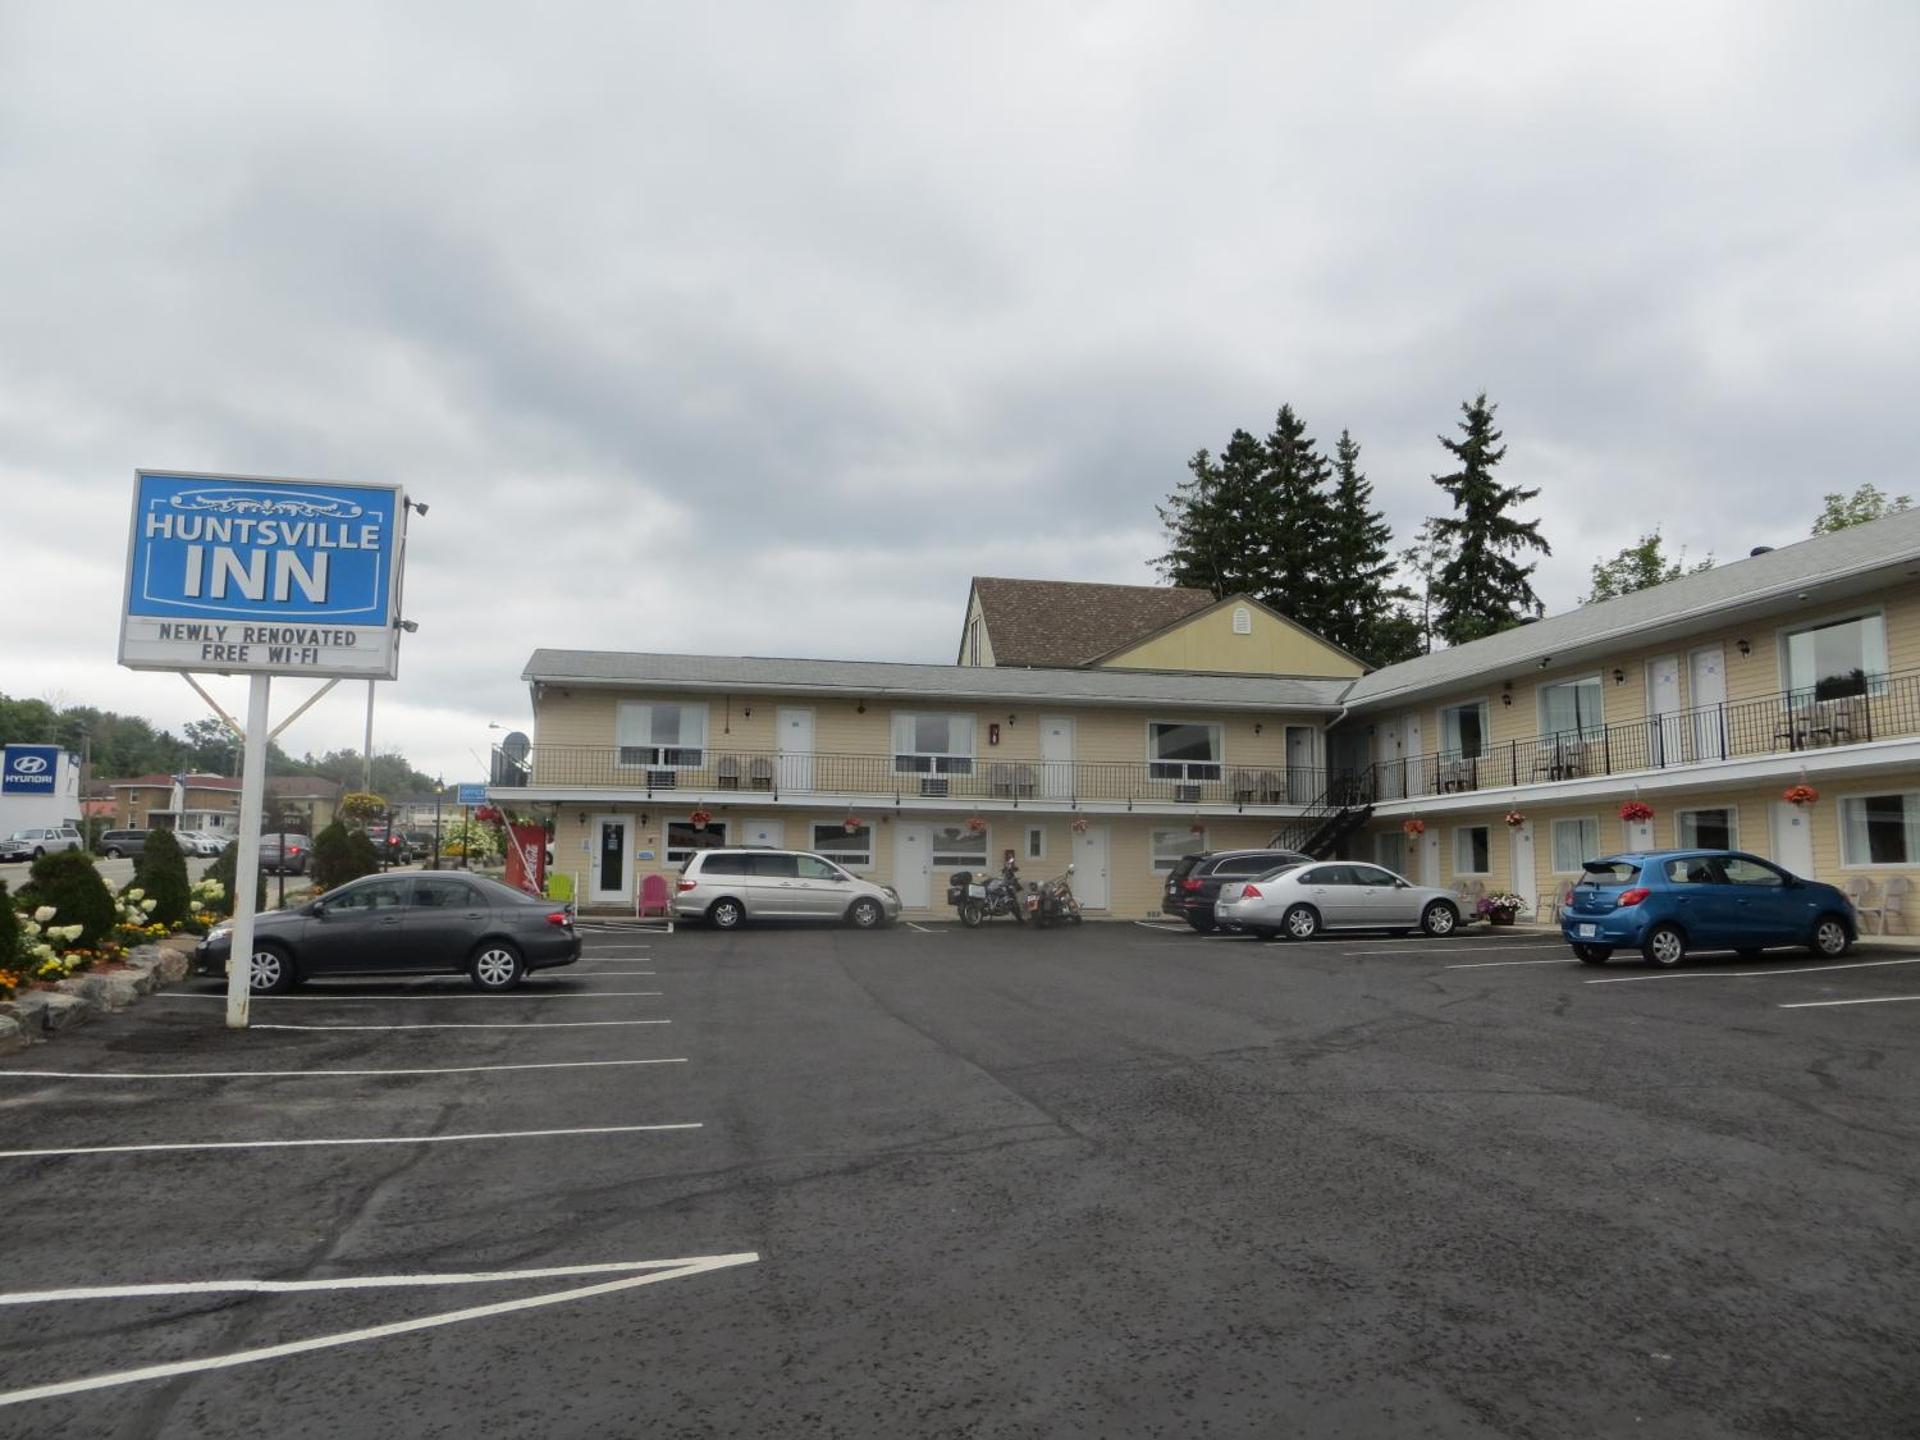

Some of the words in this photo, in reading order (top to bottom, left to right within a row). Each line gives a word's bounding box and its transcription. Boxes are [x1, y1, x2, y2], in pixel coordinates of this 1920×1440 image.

[146, 513, 380, 550] HUNTSVILLE
[184, 544, 328, 603] INN
[159, 623, 228, 641] NEWLY
[243, 627, 357, 646] RENOVATED
[201, 643, 250, 662] FREE
[268, 646, 319, 664] WI-FI
[5, 775, 52, 784] HYUNDAI
